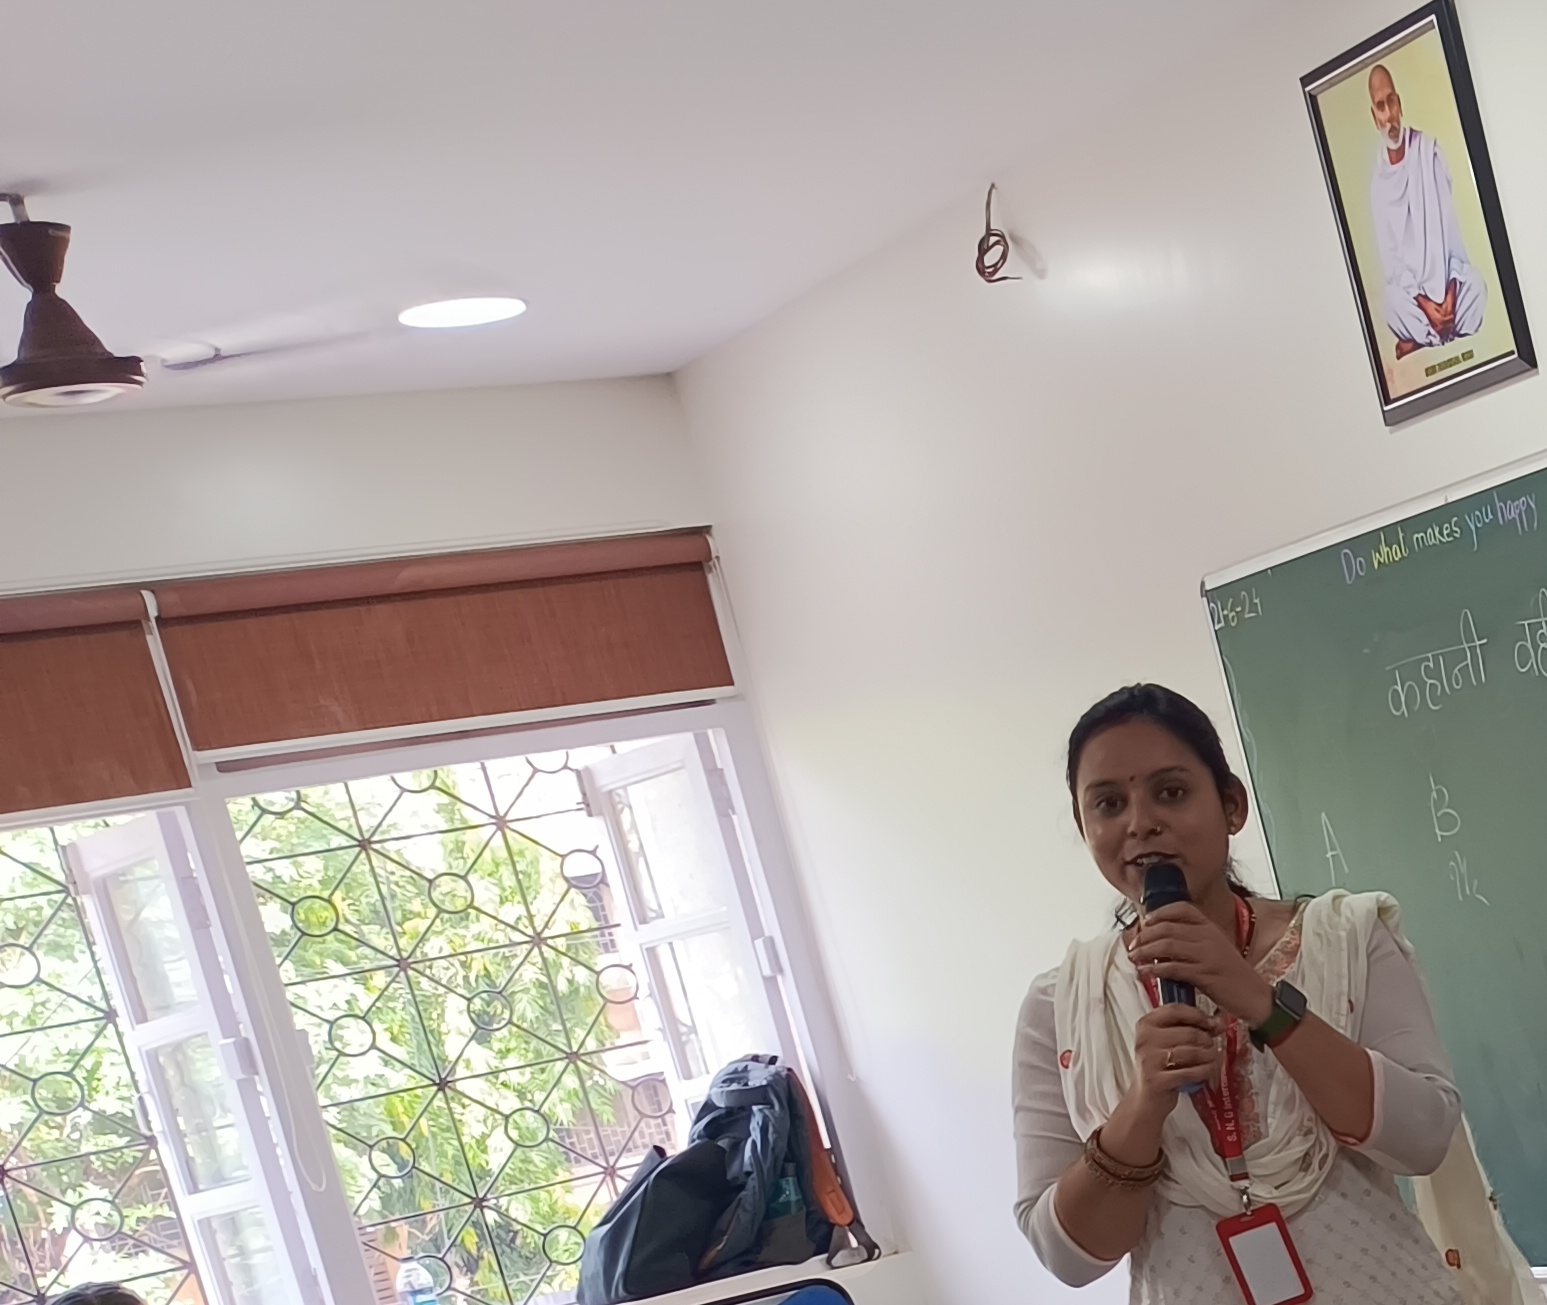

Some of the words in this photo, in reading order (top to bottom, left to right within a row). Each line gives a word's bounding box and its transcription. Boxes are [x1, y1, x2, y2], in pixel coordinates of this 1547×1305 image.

[1341, 548, 1367, 584] Do
[1371, 526, 1409, 570] what
[1413, 516, 1461, 551] makes
[1464, 506, 1494, 551] you
[1493, 490, 1537, 535] happy
[1385, 609, 1488, 718] कहानी
[1321, 811, 1349, 888] A
[1428, 771, 1461, 843] B
